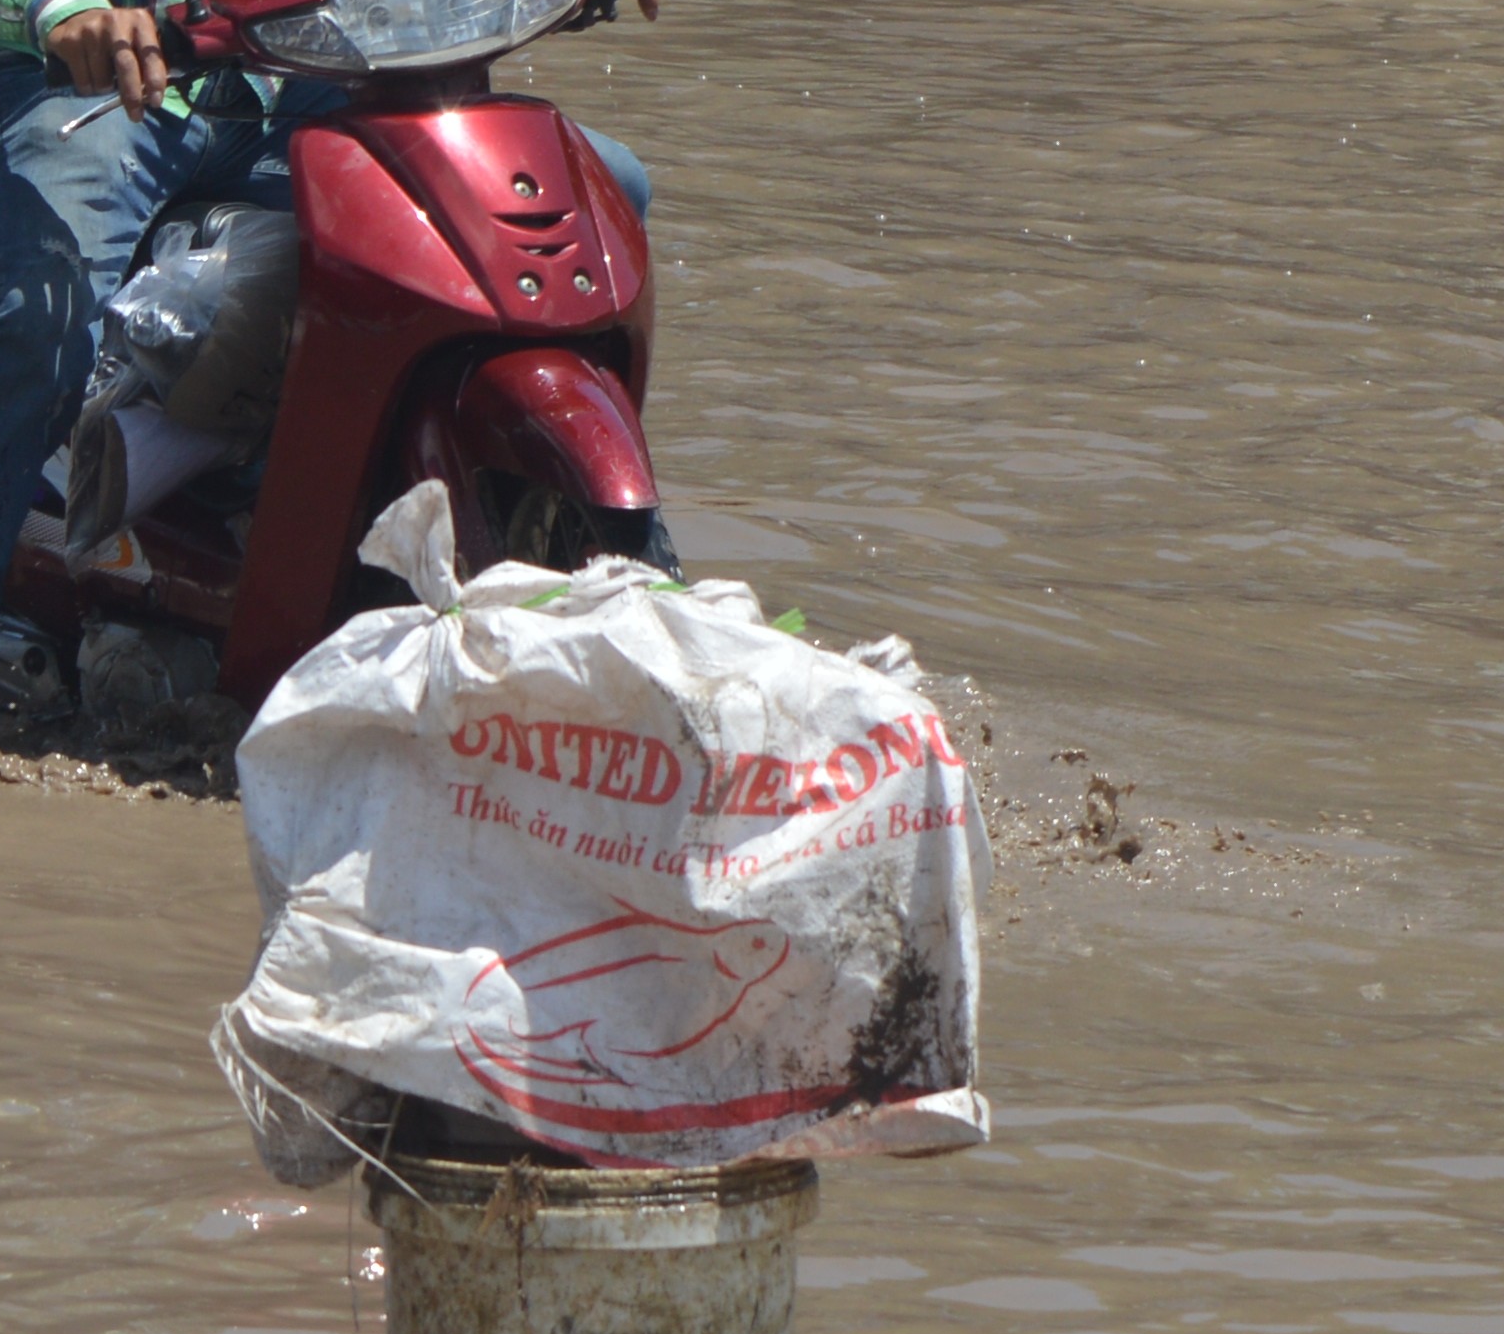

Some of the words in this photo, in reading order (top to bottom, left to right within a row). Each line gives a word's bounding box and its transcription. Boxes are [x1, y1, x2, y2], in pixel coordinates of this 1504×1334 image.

[449, 712, 682, 807] UNITED
[528, 807, 568, 848] ăn
[652, 844, 688, 877] cá
[836, 812, 877, 852] cá
[886, 800, 966, 840] Basa
